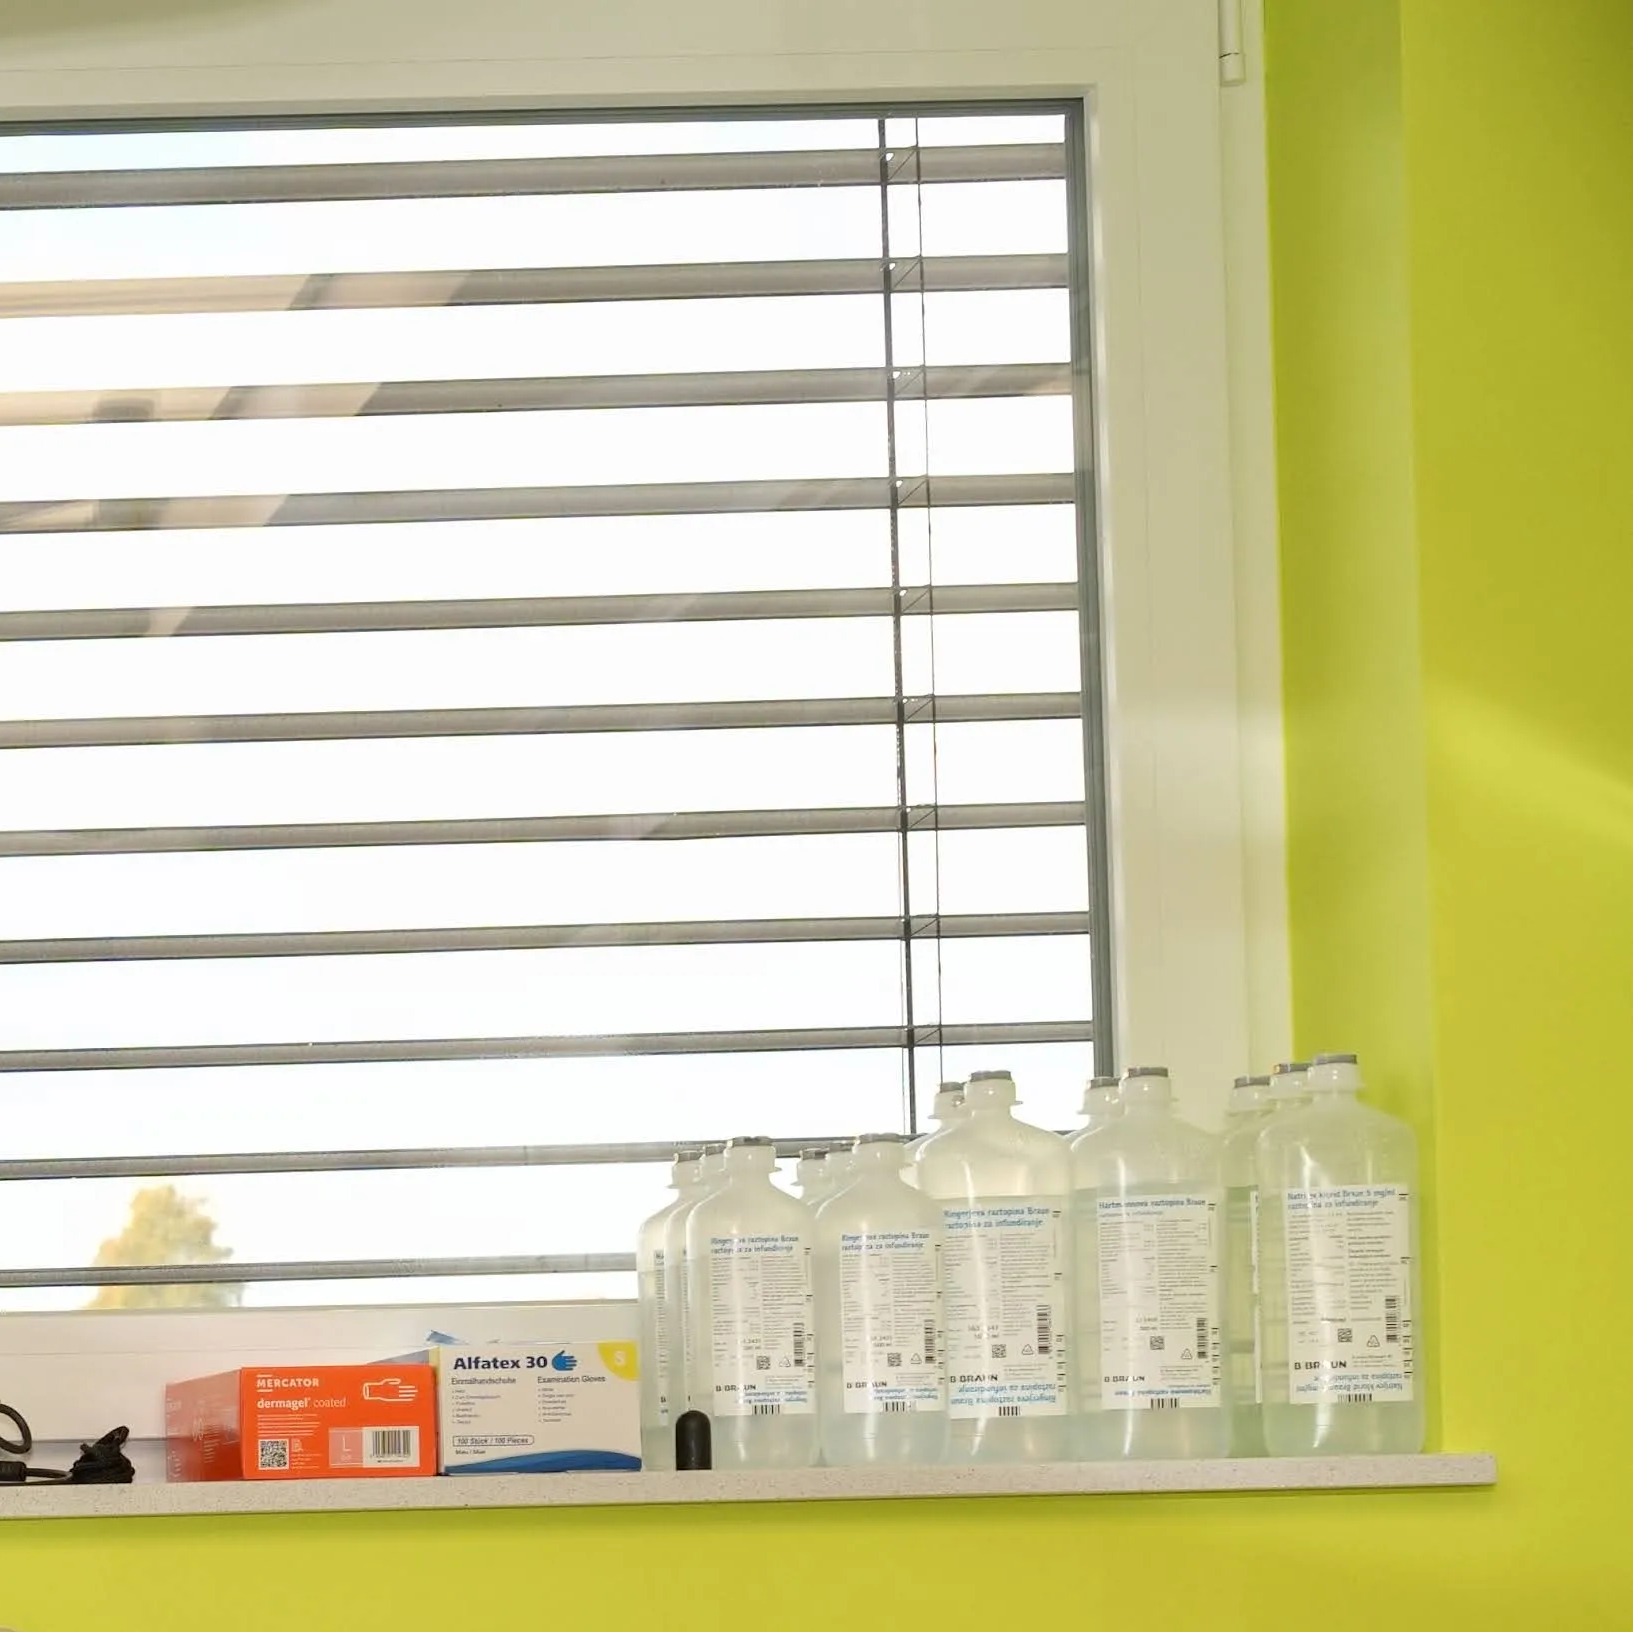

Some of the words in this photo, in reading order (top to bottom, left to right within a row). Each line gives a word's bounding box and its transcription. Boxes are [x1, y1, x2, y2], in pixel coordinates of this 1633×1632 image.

[453, 1356, 521, 1371] Alfatex
[526, 1356, 548, 1369] 30
[1305, 1361, 1347, 1370] BRUN
[257, 1377, 319, 1388] MERCATOR
[537, 1376, 580, 1384] Examination
[582, 1375, 606, 1383] Gloves
[257, 1398, 309, 1411] dermagel
[313, 1398, 346, 1408] coated
